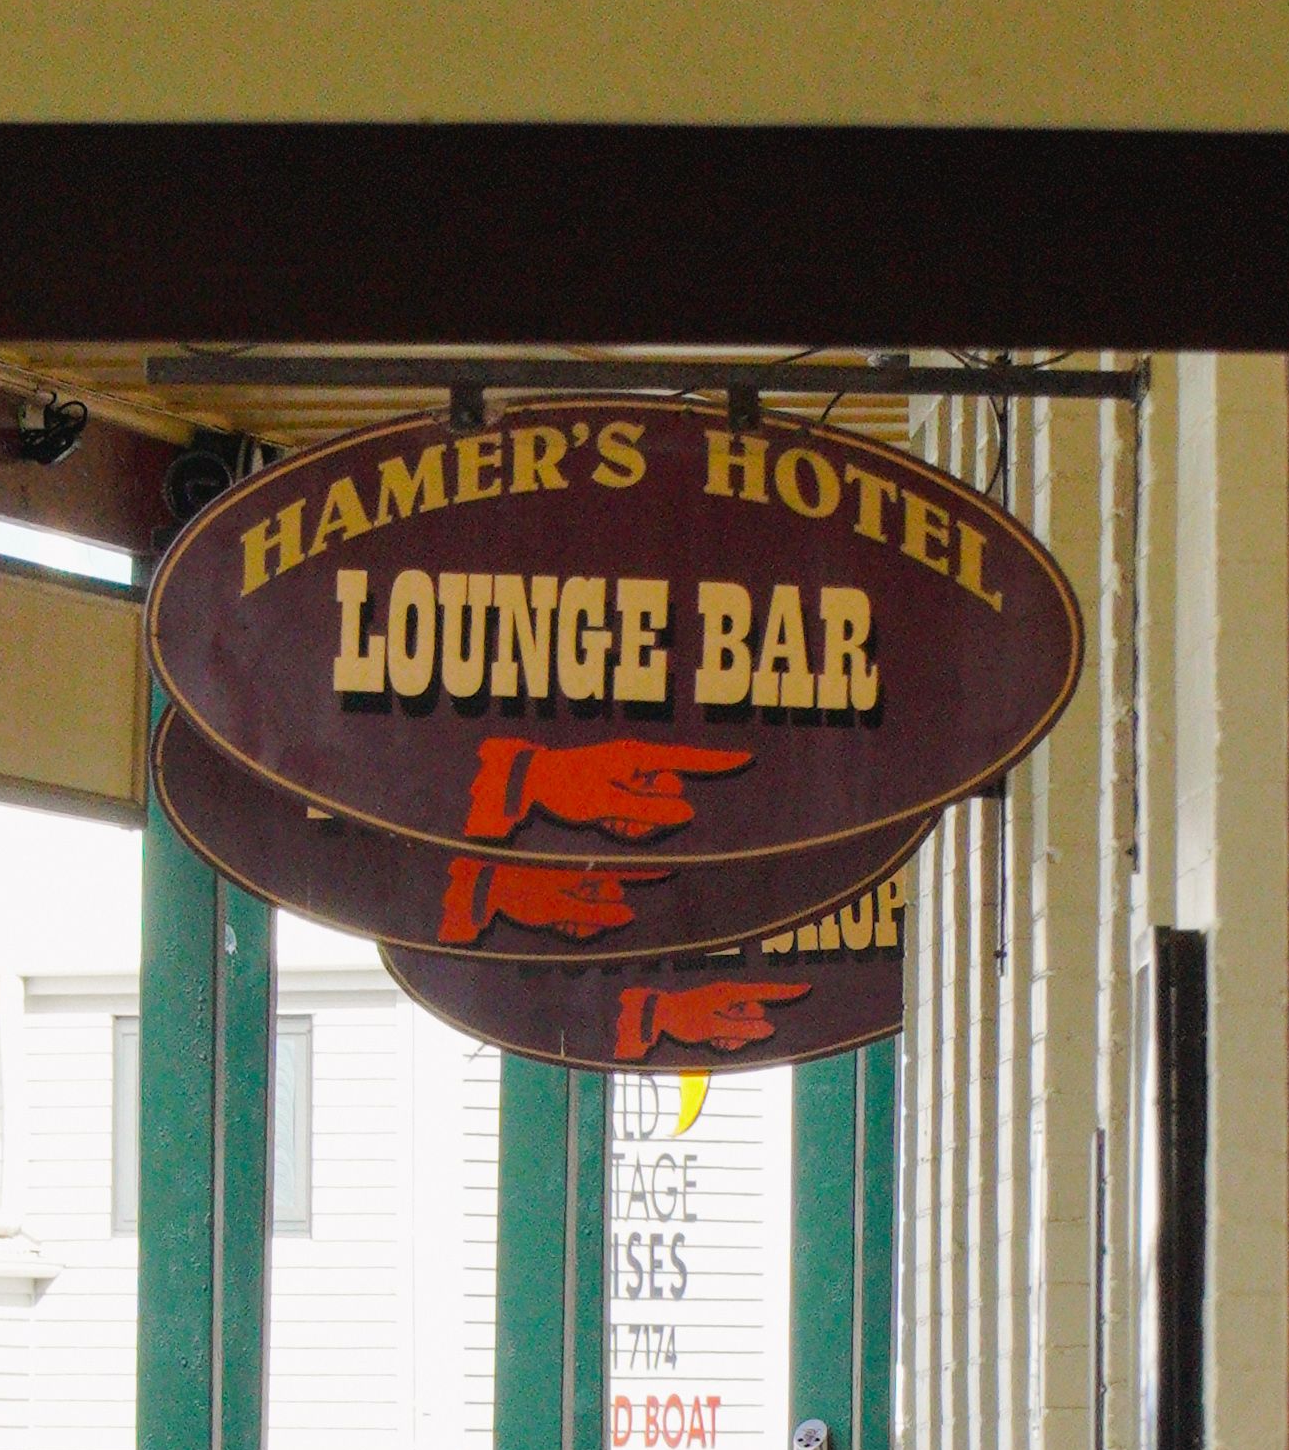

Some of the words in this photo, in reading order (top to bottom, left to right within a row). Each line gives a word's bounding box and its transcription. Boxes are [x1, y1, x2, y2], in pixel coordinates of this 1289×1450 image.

[240, 421, 647, 598] HAMER'S
[703, 428, 1003, 614] HOTEL
[332, 569, 670, 703] LOUNGE
[694, 580, 880, 713] BAR
[644, 1393, 722, 1450] BOAT
